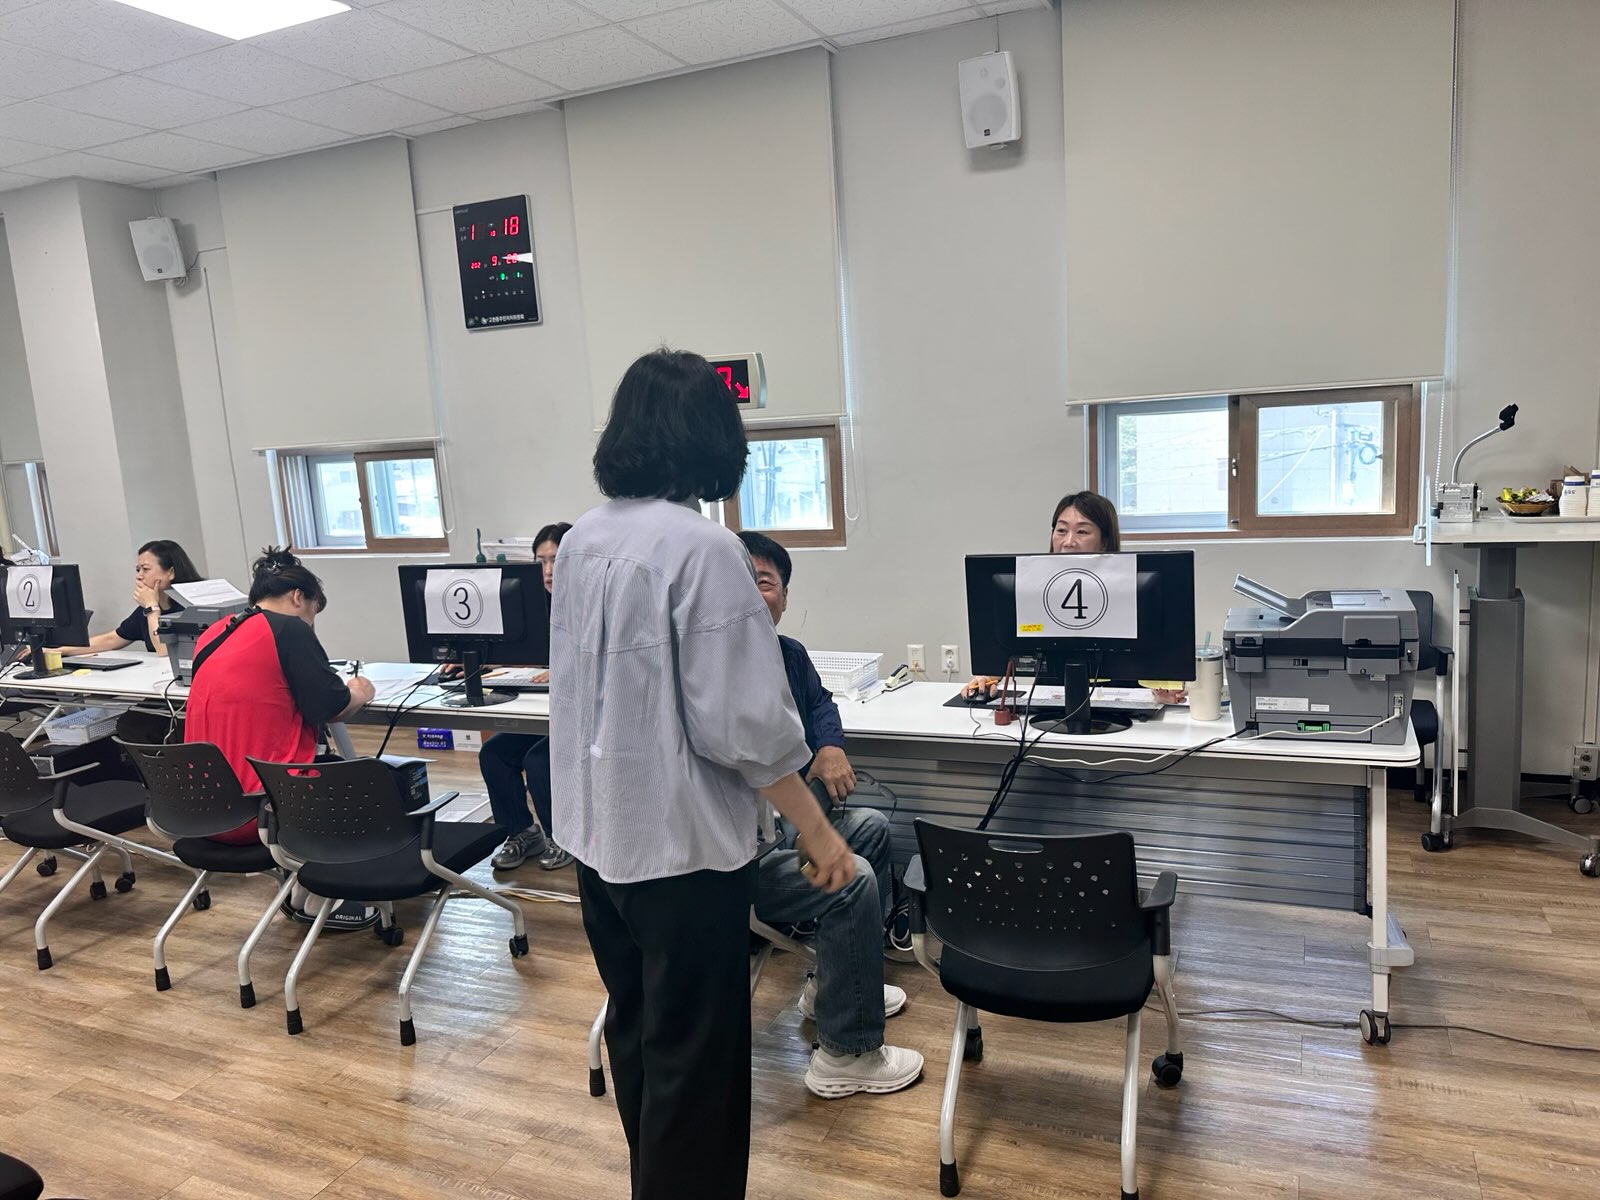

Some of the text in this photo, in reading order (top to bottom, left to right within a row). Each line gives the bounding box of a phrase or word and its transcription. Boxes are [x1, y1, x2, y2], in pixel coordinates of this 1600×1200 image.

[504, 215, 519, 236] 18
[23, 580, 35, 607] 2
[453, 586, 471, 620] 3
[1061, 578, 1088, 619] 4
[335, 913, 362, 921] ORIGINAL
